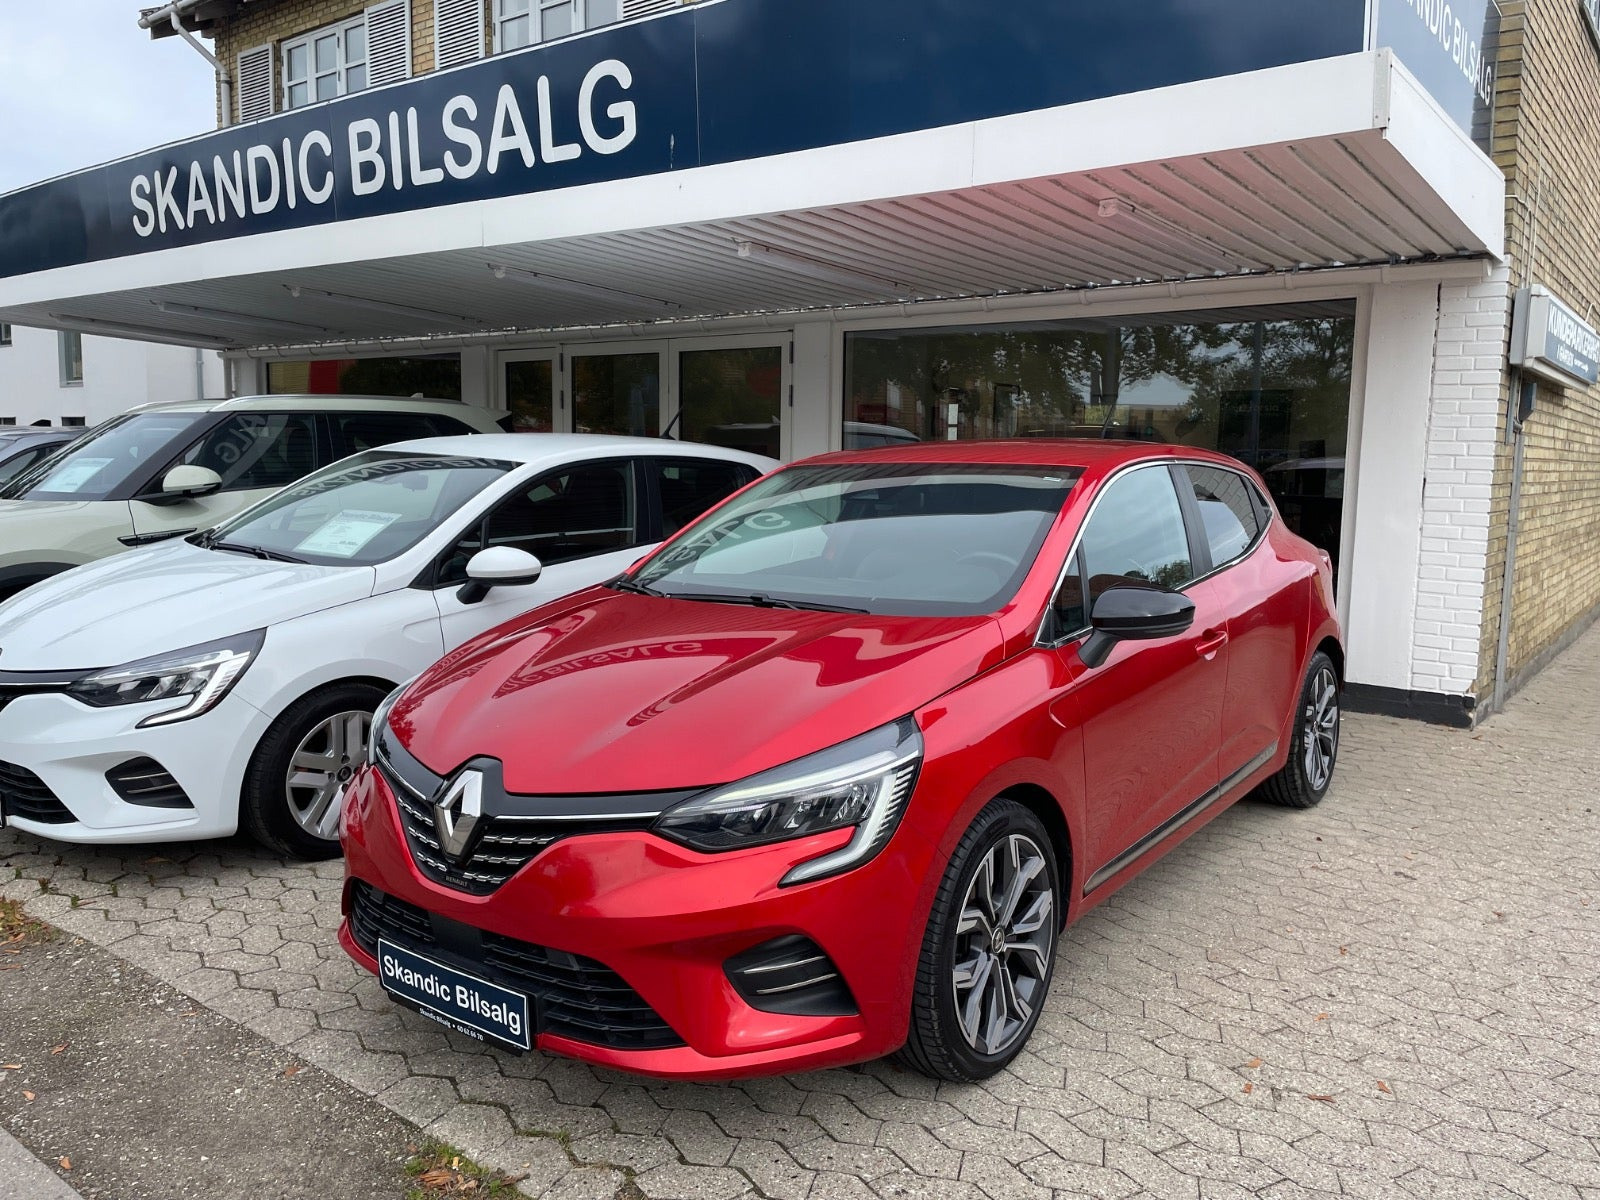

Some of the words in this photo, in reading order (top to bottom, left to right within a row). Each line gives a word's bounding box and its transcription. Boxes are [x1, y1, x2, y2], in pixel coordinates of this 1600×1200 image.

[1406, 0, 1452, 52] NDIC
[1452, 16, 1492, 106] BILSALG
[130, 130, 334, 237] SKANDIC
[348, 59, 637, 197] BILSALG
[383, 955, 451, 1002] Skandic
[456, 985, 521, 1036] Bilsalg
